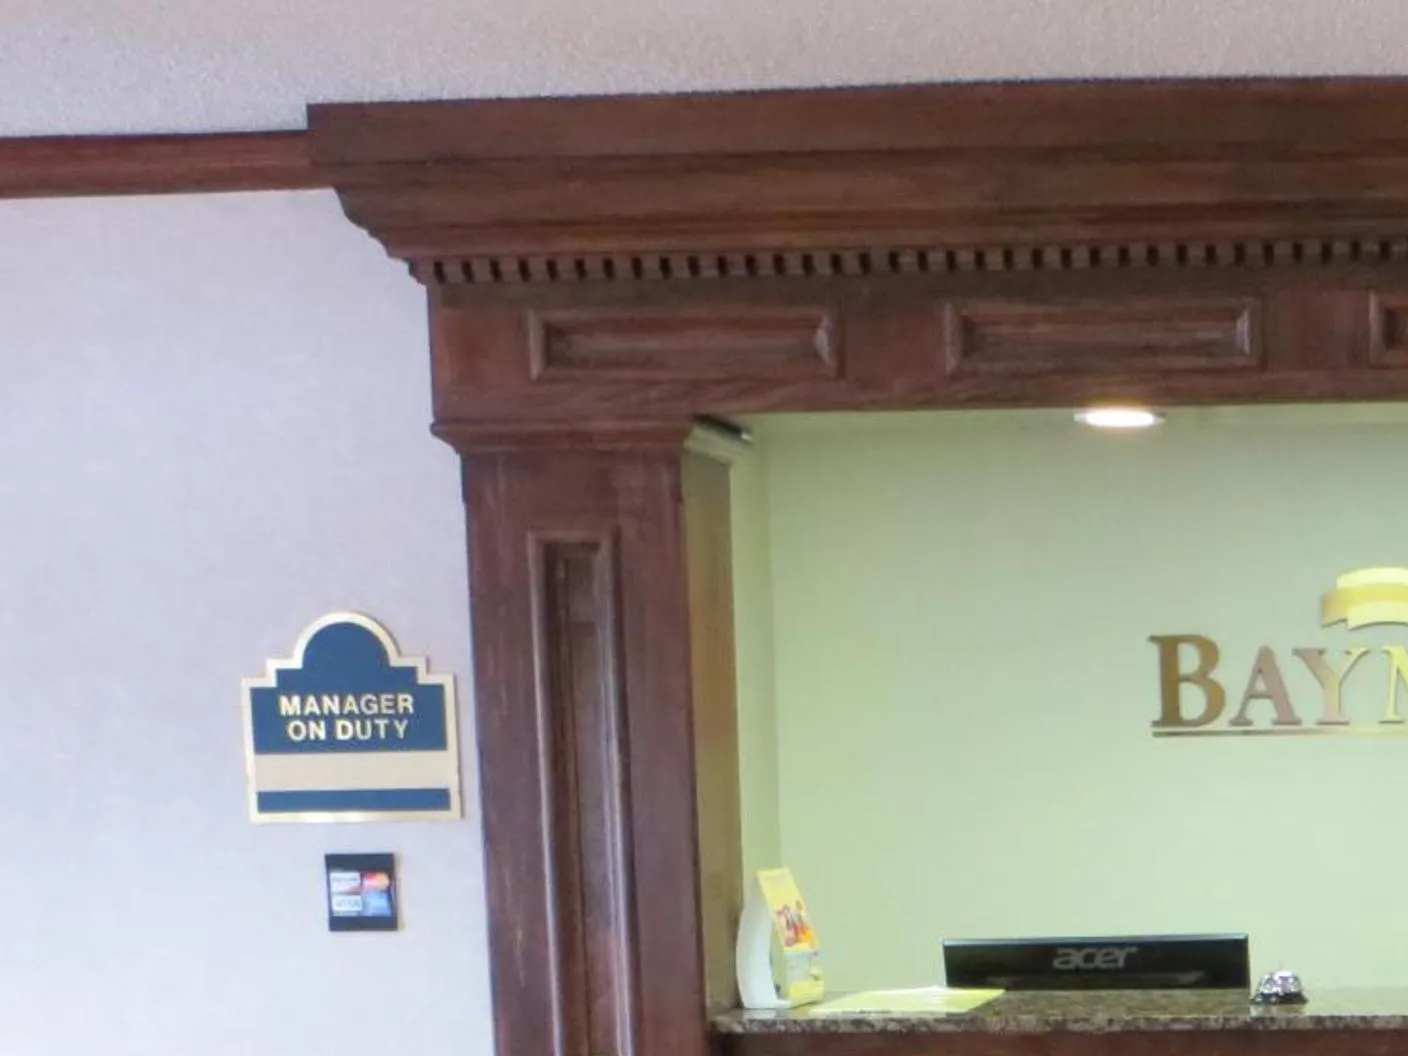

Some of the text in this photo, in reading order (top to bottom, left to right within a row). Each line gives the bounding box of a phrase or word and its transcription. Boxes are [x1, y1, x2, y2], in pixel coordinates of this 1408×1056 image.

[279, 693, 414, 716] MANAGER
[287, 719, 408, 741] ON DUTY
[1052, 946, 1138, 970] acer
